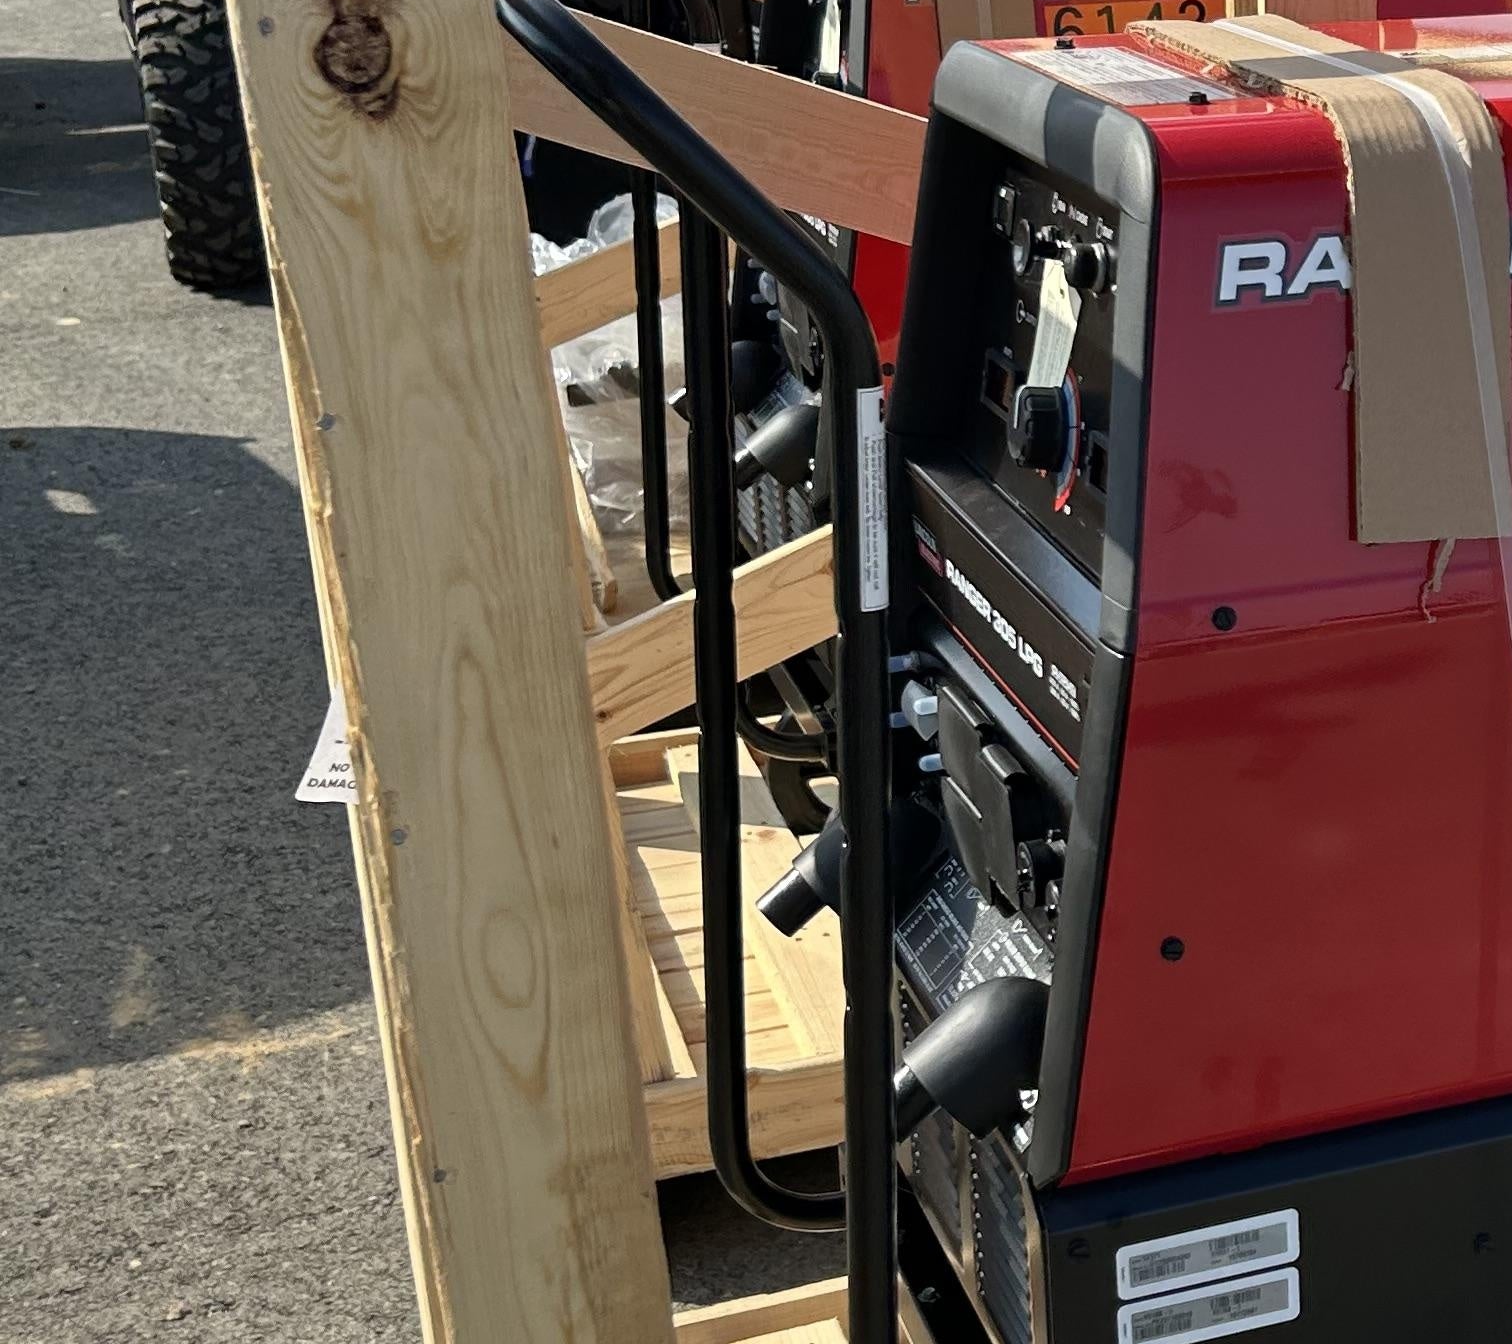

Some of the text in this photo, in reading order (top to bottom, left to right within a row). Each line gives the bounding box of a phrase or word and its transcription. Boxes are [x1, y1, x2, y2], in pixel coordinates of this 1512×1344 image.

[945, 559, 1043, 678] RANGER 305 LPG
[329, 763, 350, 772] NO
